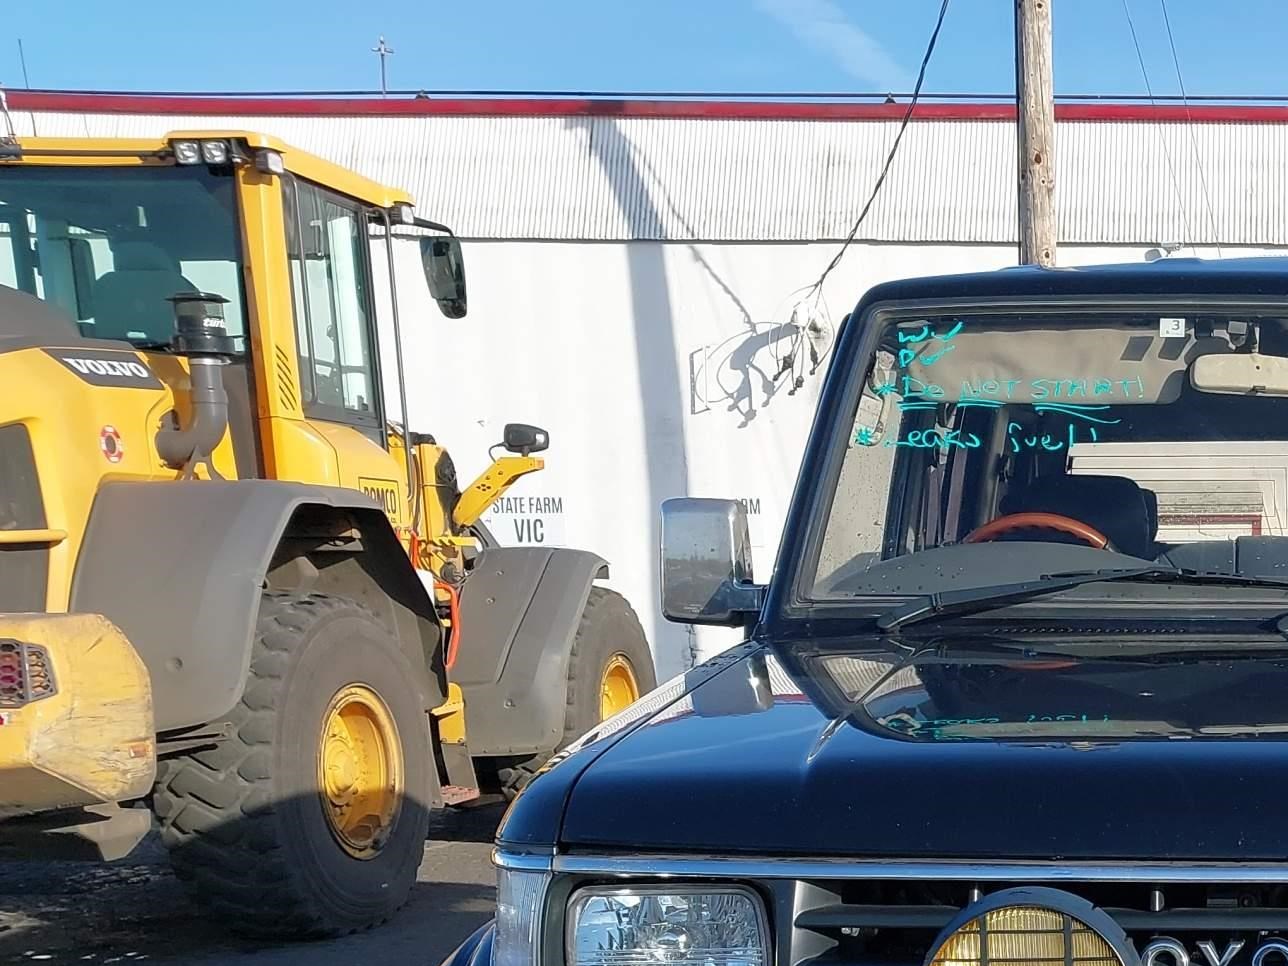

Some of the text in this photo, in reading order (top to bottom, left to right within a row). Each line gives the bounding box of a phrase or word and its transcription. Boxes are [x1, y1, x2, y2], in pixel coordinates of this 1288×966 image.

[203, 317, 226, 328] tur
[62, 357, 150, 379] VOLVO
[493, 496, 564, 514] STATE FARM
[513, 518, 545, 543] VIC
